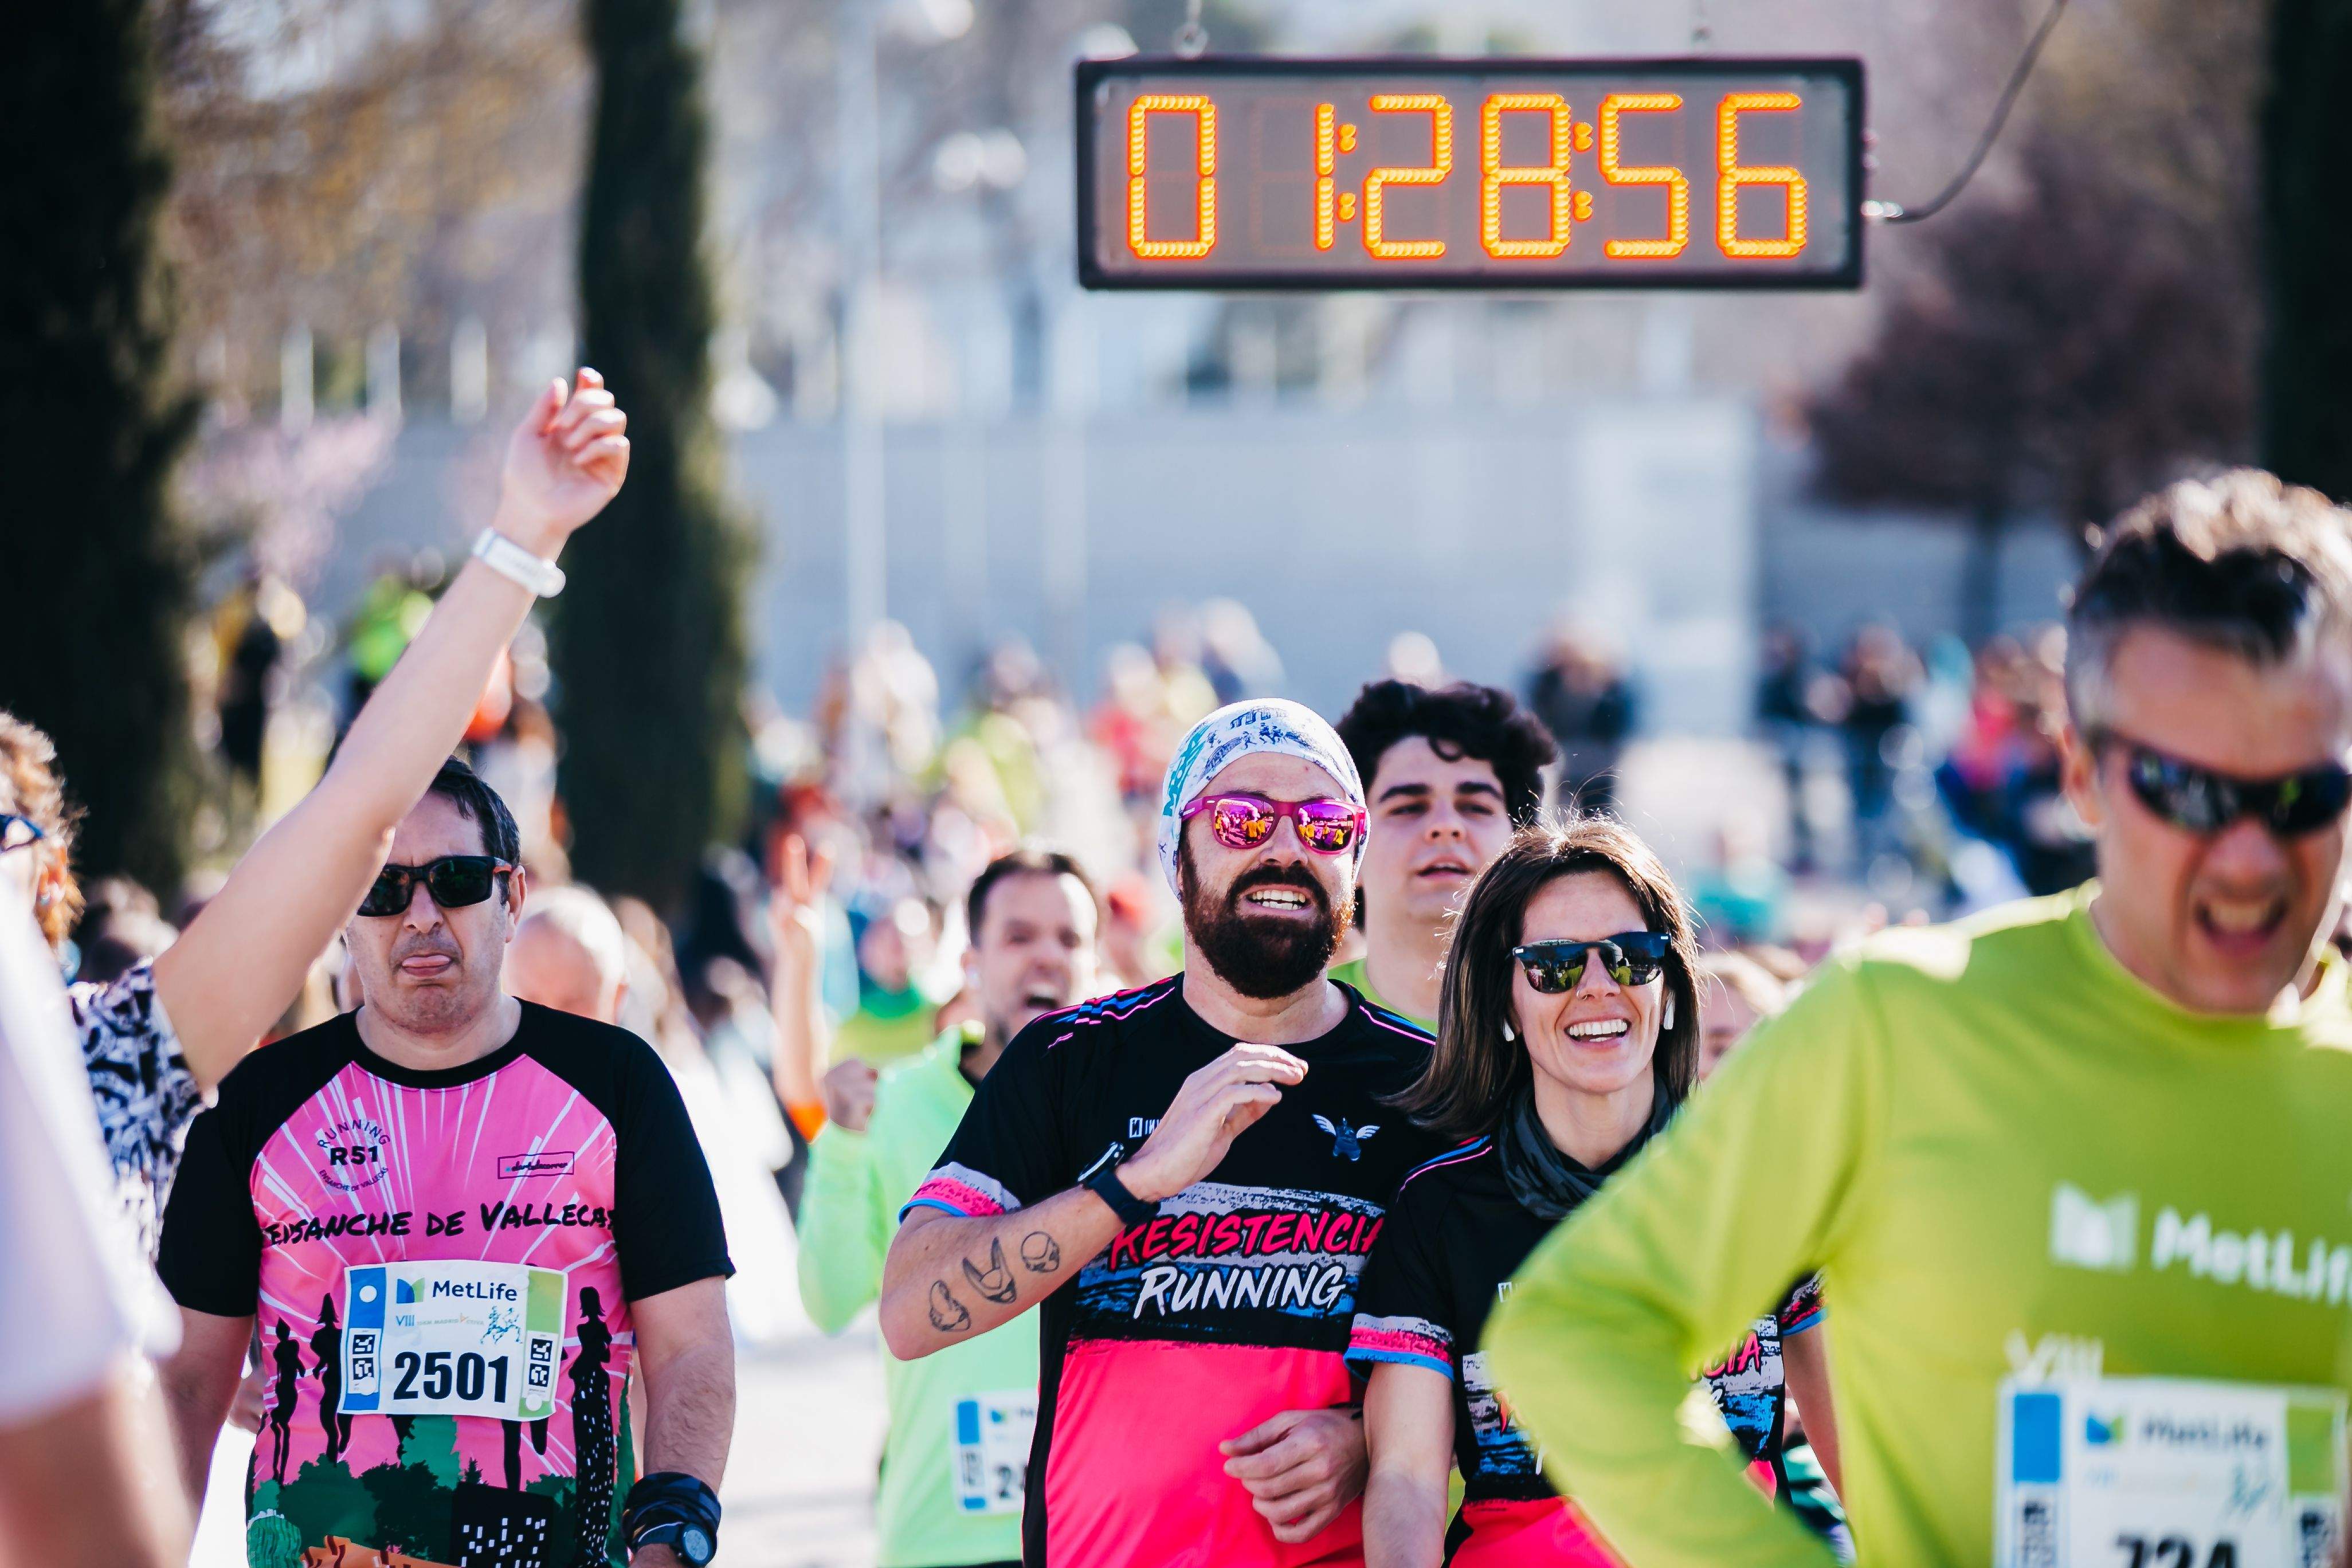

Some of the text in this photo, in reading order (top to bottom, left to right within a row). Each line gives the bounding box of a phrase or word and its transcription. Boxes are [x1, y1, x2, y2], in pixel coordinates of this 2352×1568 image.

[1128, 93, 1807, 257] 01:28:56
[317, 1119, 391, 1148] RUNNING
[330, 1145, 378, 1166] R51
[426, 1210, 466, 1237] DE
[2151, 1206, 2352, 1307] MetLif
[432, 1280, 518, 1301] MetLife
[1133, 1265, 1347, 1319] RUNNING
[395, 1314, 415, 1327] VIII
[393, 1351, 509, 1404] 2501
